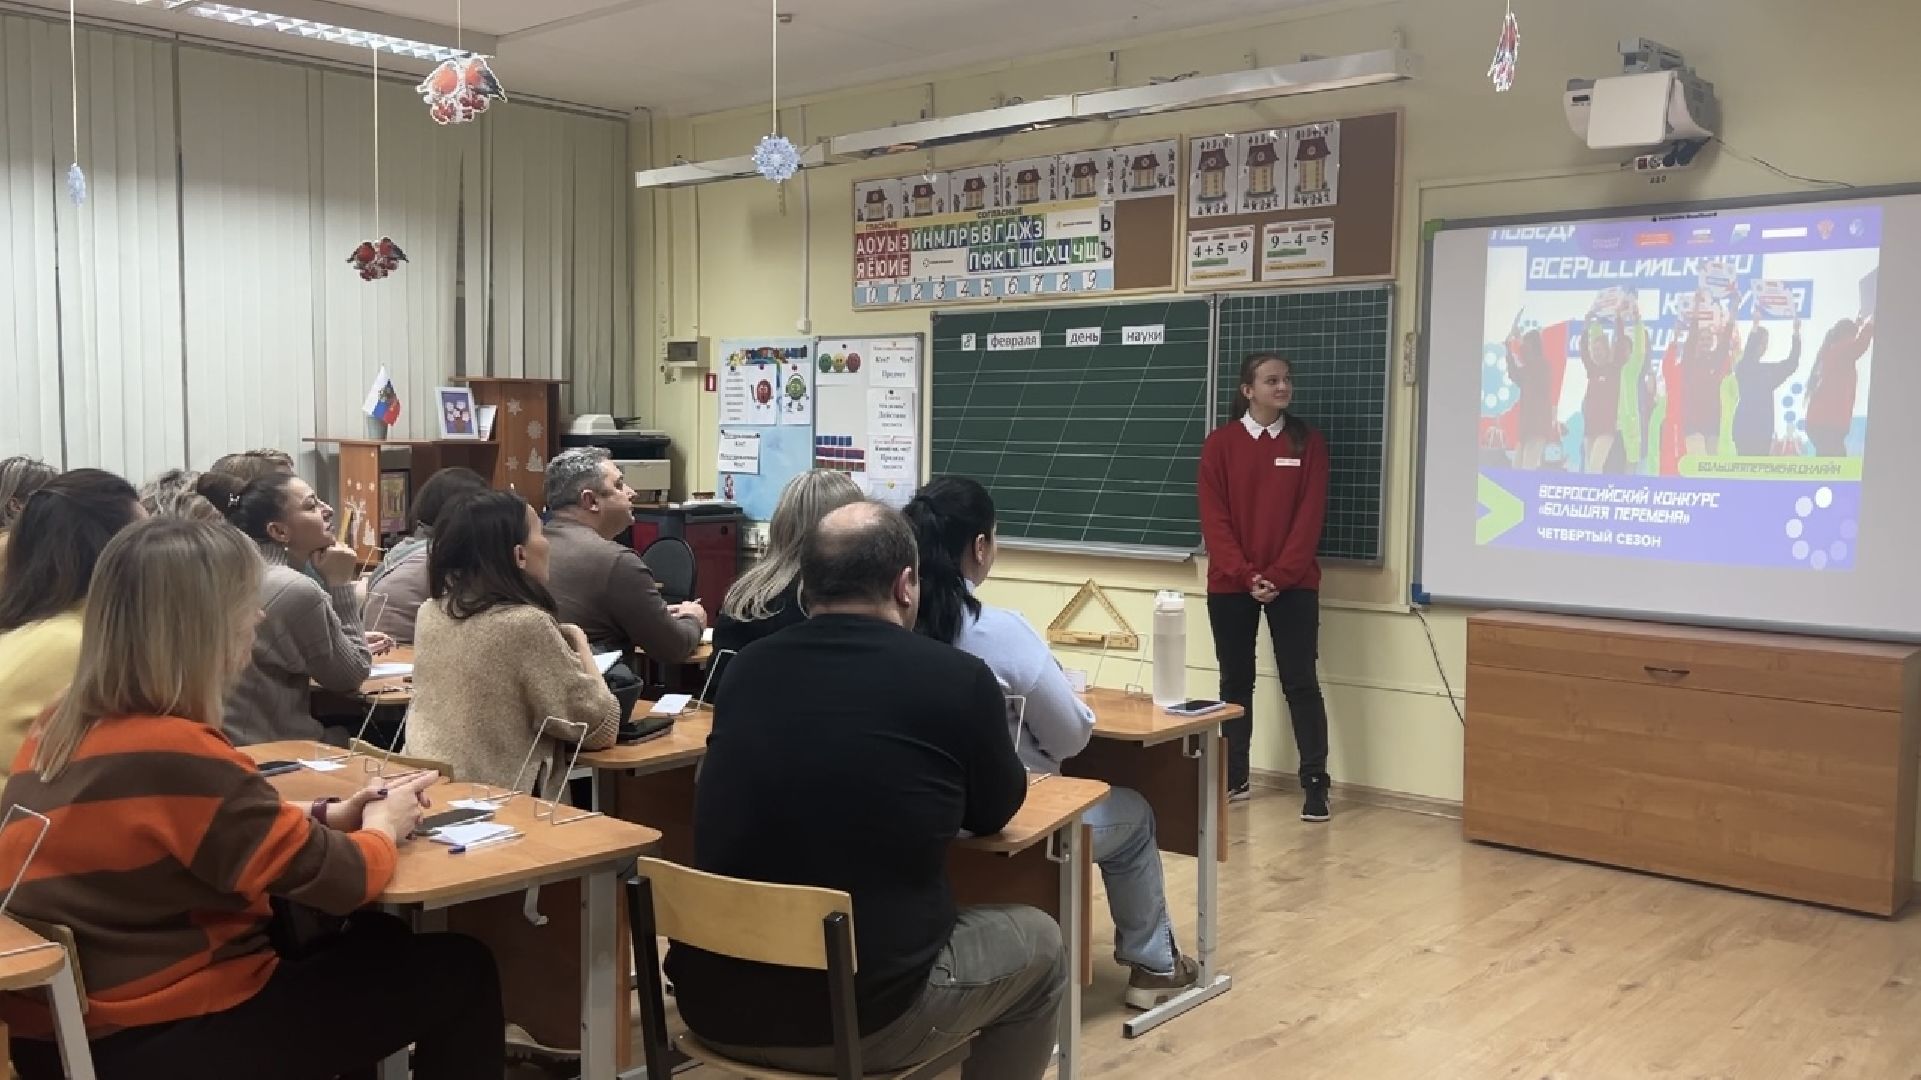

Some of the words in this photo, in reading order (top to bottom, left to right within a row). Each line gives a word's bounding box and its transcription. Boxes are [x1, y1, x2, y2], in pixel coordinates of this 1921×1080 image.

[1193, 245, 1202, 258] 4
[1216, 243, 1224, 256] 5
[1240, 240, 1248, 254] 9
[1271, 235, 1280, 249] 9
[1294, 233, 1302, 247] 4
[1321, 230, 1329, 246] 5
[990, 334, 1037, 350] февраля
[1070, 331, 1099, 344] день
[1126, 330, 1162, 345] науки
[1538, 484, 1649, 504] ВСЕРОССИЙСКИЙ
[1653, 491, 1721, 508] КОНКУРС
[1538, 501, 1610, 520] «БОЛЬШАЯ
[1614, 506, 1690, 525] ПЕРЕМЕНА»
[1536, 526, 1613, 545] ЧЕТВЕРТЫЙ
[1616, 533, 1662, 548] СЕЗОН
